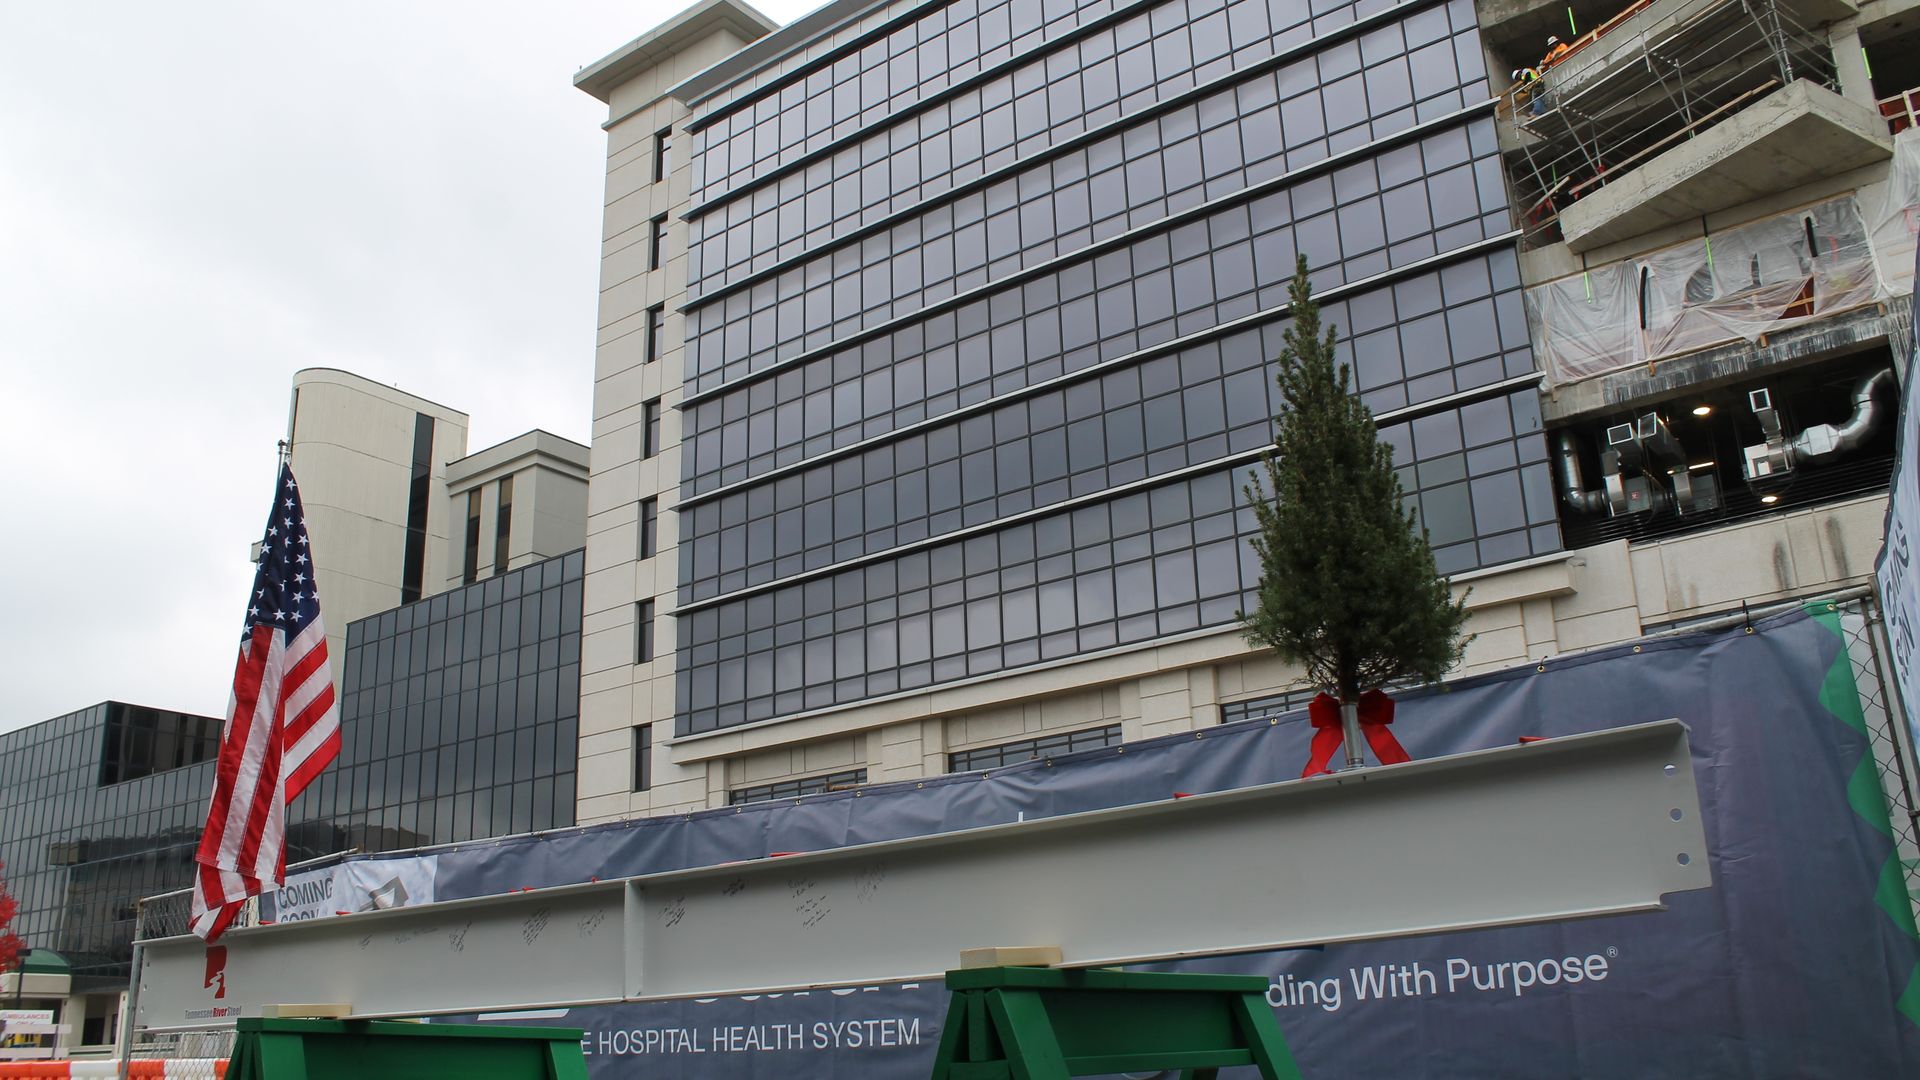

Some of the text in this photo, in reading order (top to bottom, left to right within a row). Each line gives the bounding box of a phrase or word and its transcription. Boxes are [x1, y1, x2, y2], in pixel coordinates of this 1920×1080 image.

[278, 877, 334, 909] COMING
[1265, 974, 1341, 1012] ding
[1350, 962, 1437, 1000] With
[599, 1027, 706, 1056] HOSPITAL
[713, 1023, 804, 1052] HEALTH
[812, 1017, 920, 1050] SYSTEM
